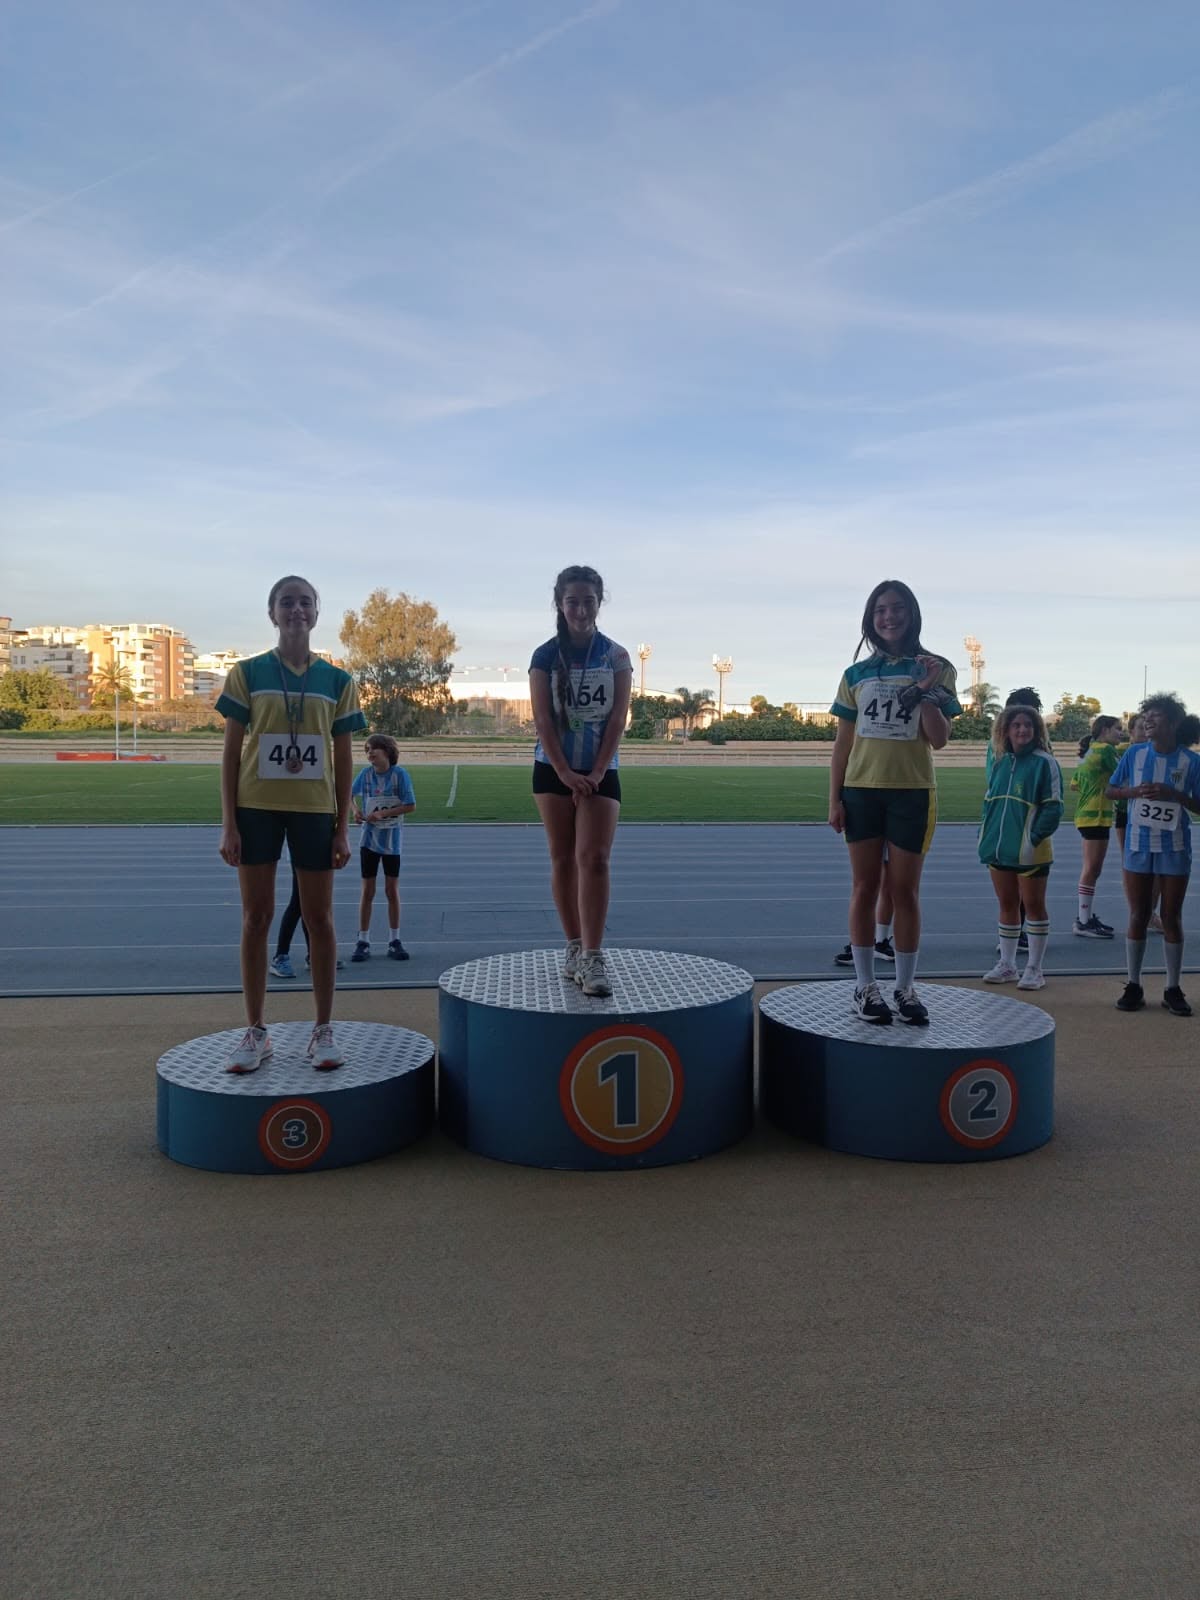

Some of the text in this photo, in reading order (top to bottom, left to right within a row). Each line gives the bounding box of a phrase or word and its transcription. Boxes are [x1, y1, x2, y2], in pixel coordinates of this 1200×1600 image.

[864, 698, 912, 725] 414
[268, 744, 318, 767] 404
[1140, 803, 1175, 822] 325
[598, 1051, 639, 1128] 1
[967, 1079, 998, 1122] 2
[282, 1118, 308, 1149] 3
